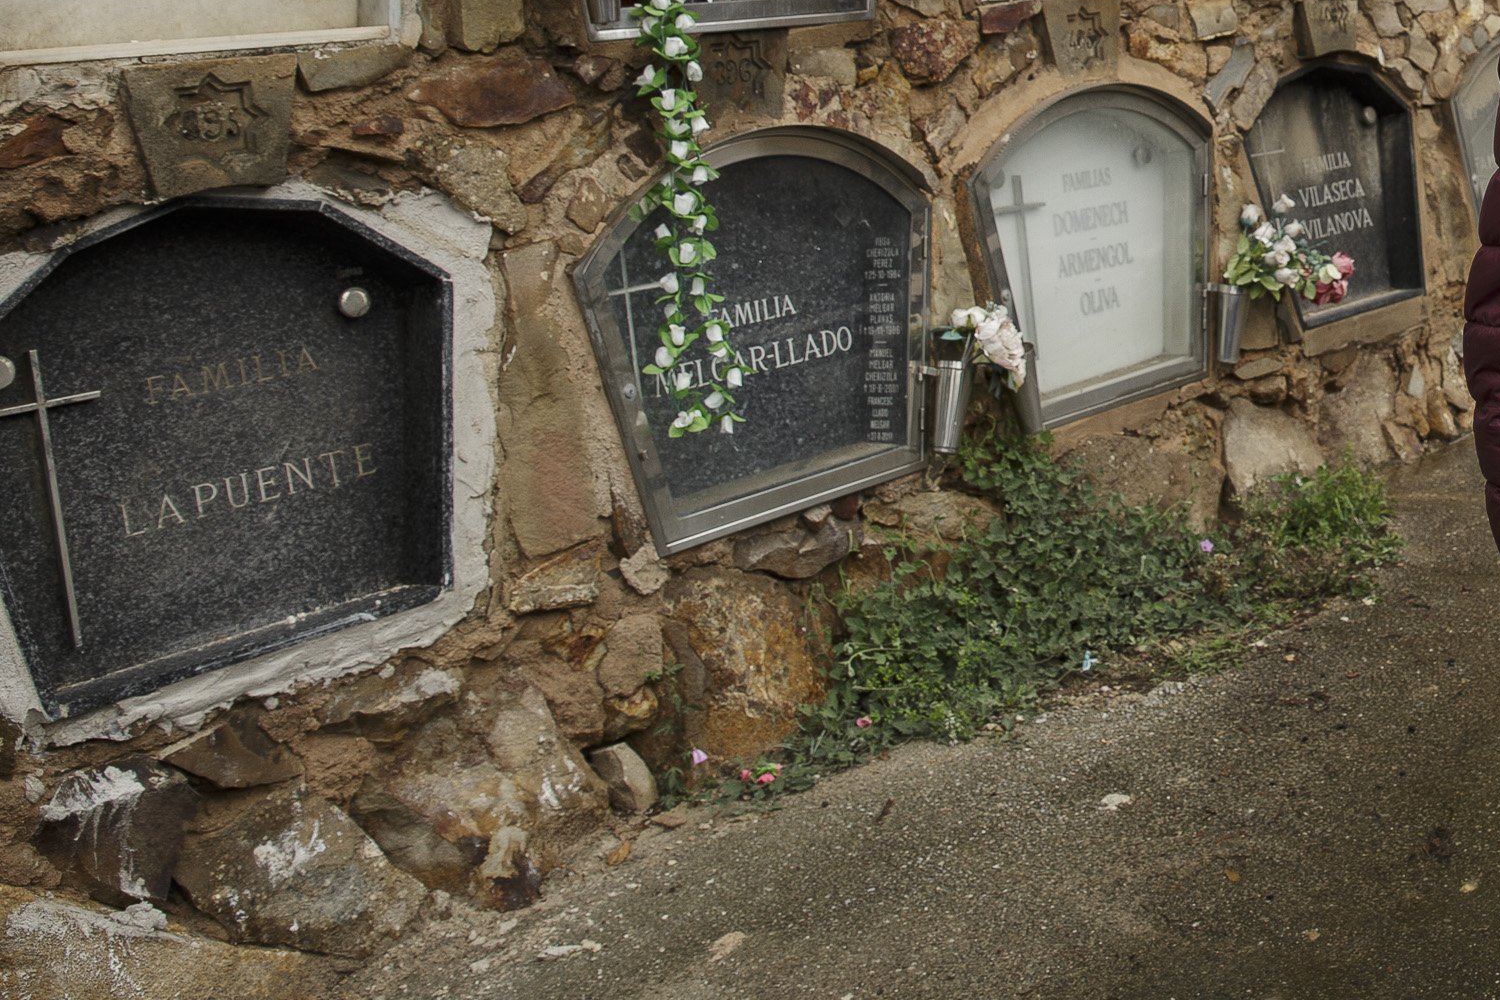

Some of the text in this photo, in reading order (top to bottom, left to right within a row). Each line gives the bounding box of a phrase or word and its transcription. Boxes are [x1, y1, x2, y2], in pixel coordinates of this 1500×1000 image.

[1302, 150, 1352, 175] FAMILIA
[1298, 177, 1366, 208] VILASECA
[1052, 200, 1130, 238] DOMENECH
[1301, 207, 1374, 240] VILANOVA
[1058, 240, 1135, 280] ARMENGOL
[1079, 285, 1121, 317] OLIVA
[146, 345, 321, 405] FAMILIA
